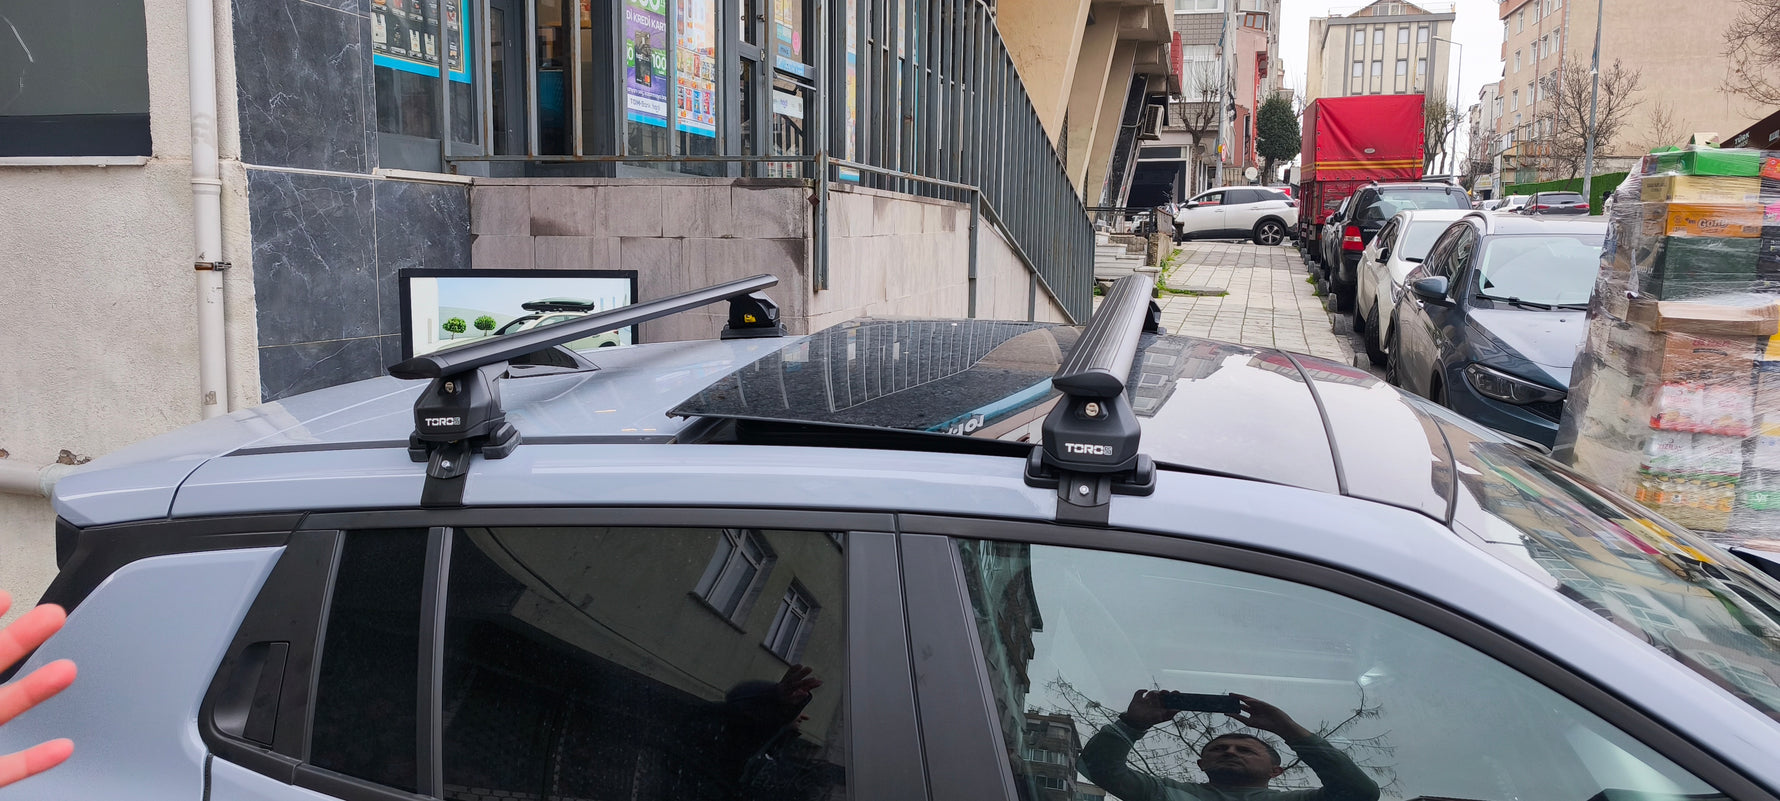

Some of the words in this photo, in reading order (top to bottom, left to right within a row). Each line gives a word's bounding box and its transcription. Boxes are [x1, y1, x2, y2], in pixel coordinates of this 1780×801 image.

[633, 12, 651, 27] KREDİ
[425, 417, 461, 427] TOROS
[1065, 442, 1113, 456] TOROS
